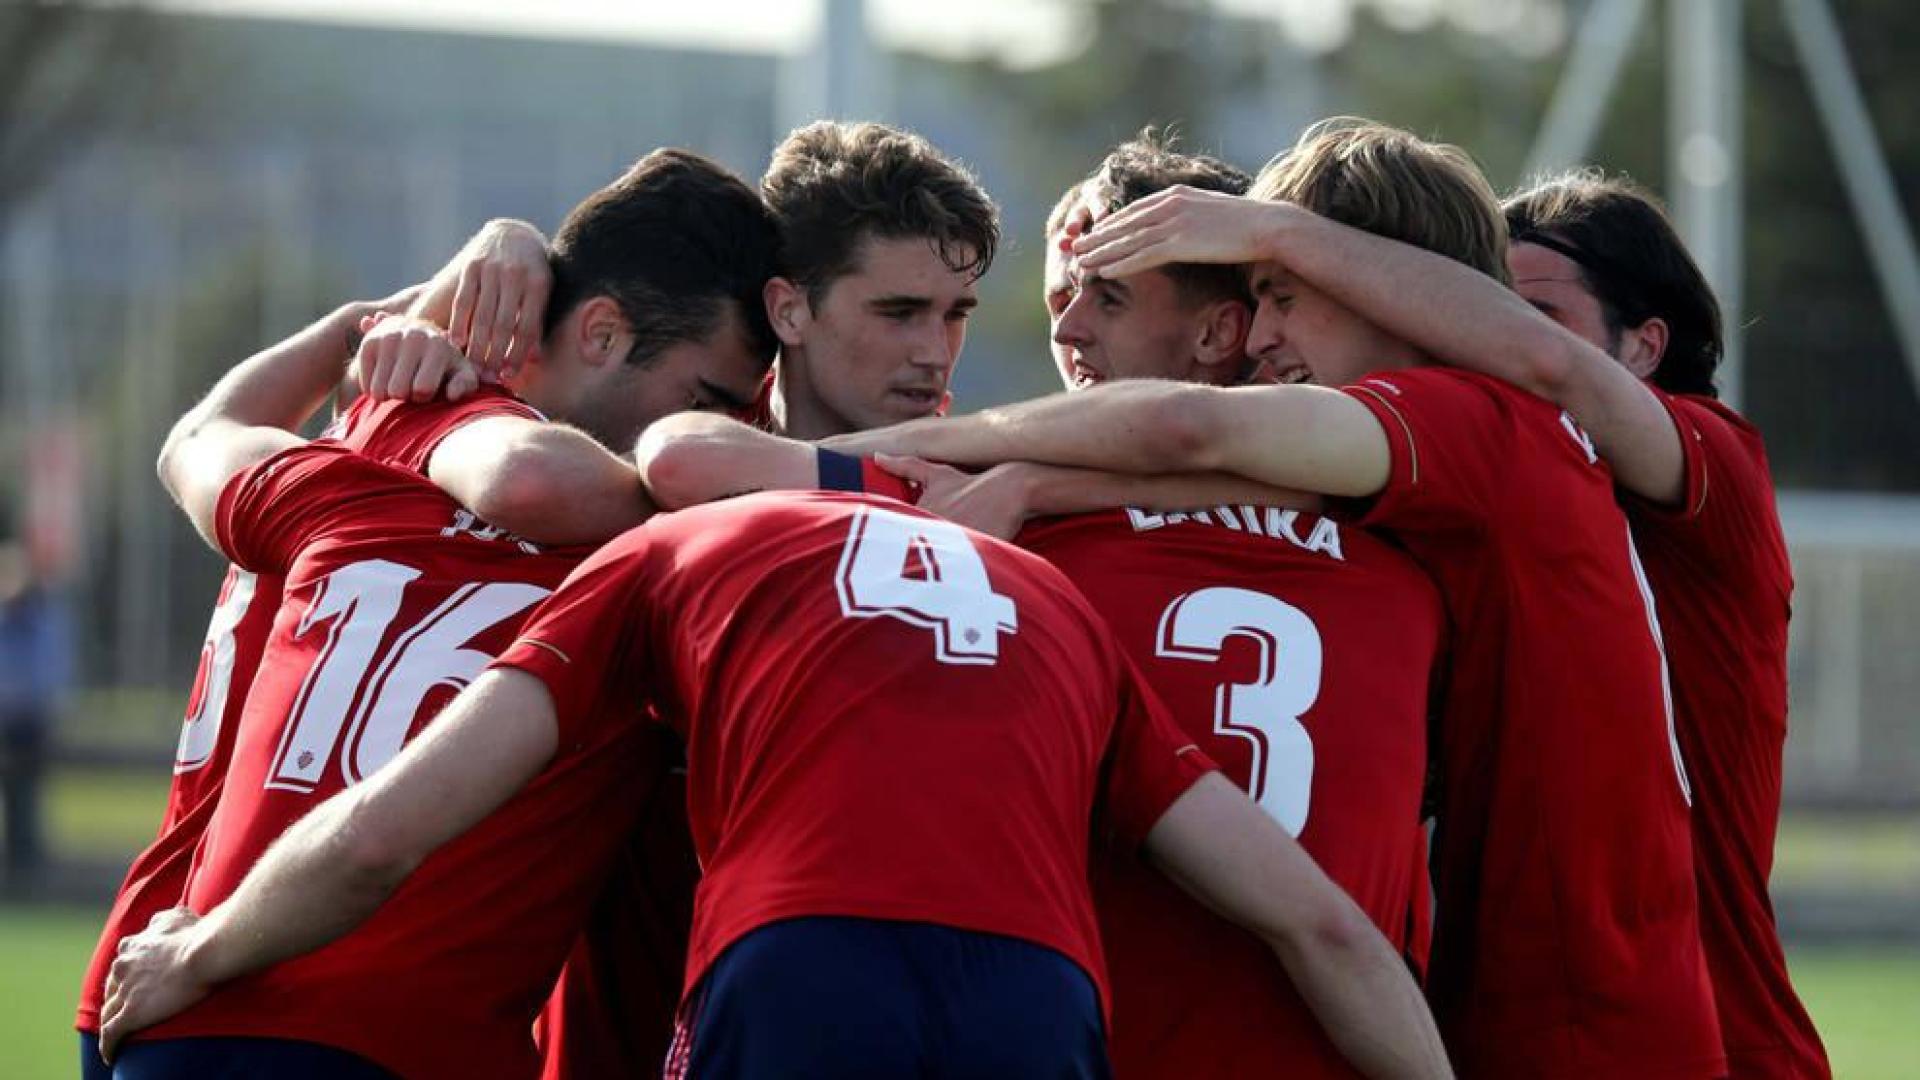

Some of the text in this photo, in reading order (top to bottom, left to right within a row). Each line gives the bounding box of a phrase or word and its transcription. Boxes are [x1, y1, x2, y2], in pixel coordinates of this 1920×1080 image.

[264, 558, 553, 793] 16
[834, 503, 1018, 666] 4
[1155, 586, 1323, 840] 3
